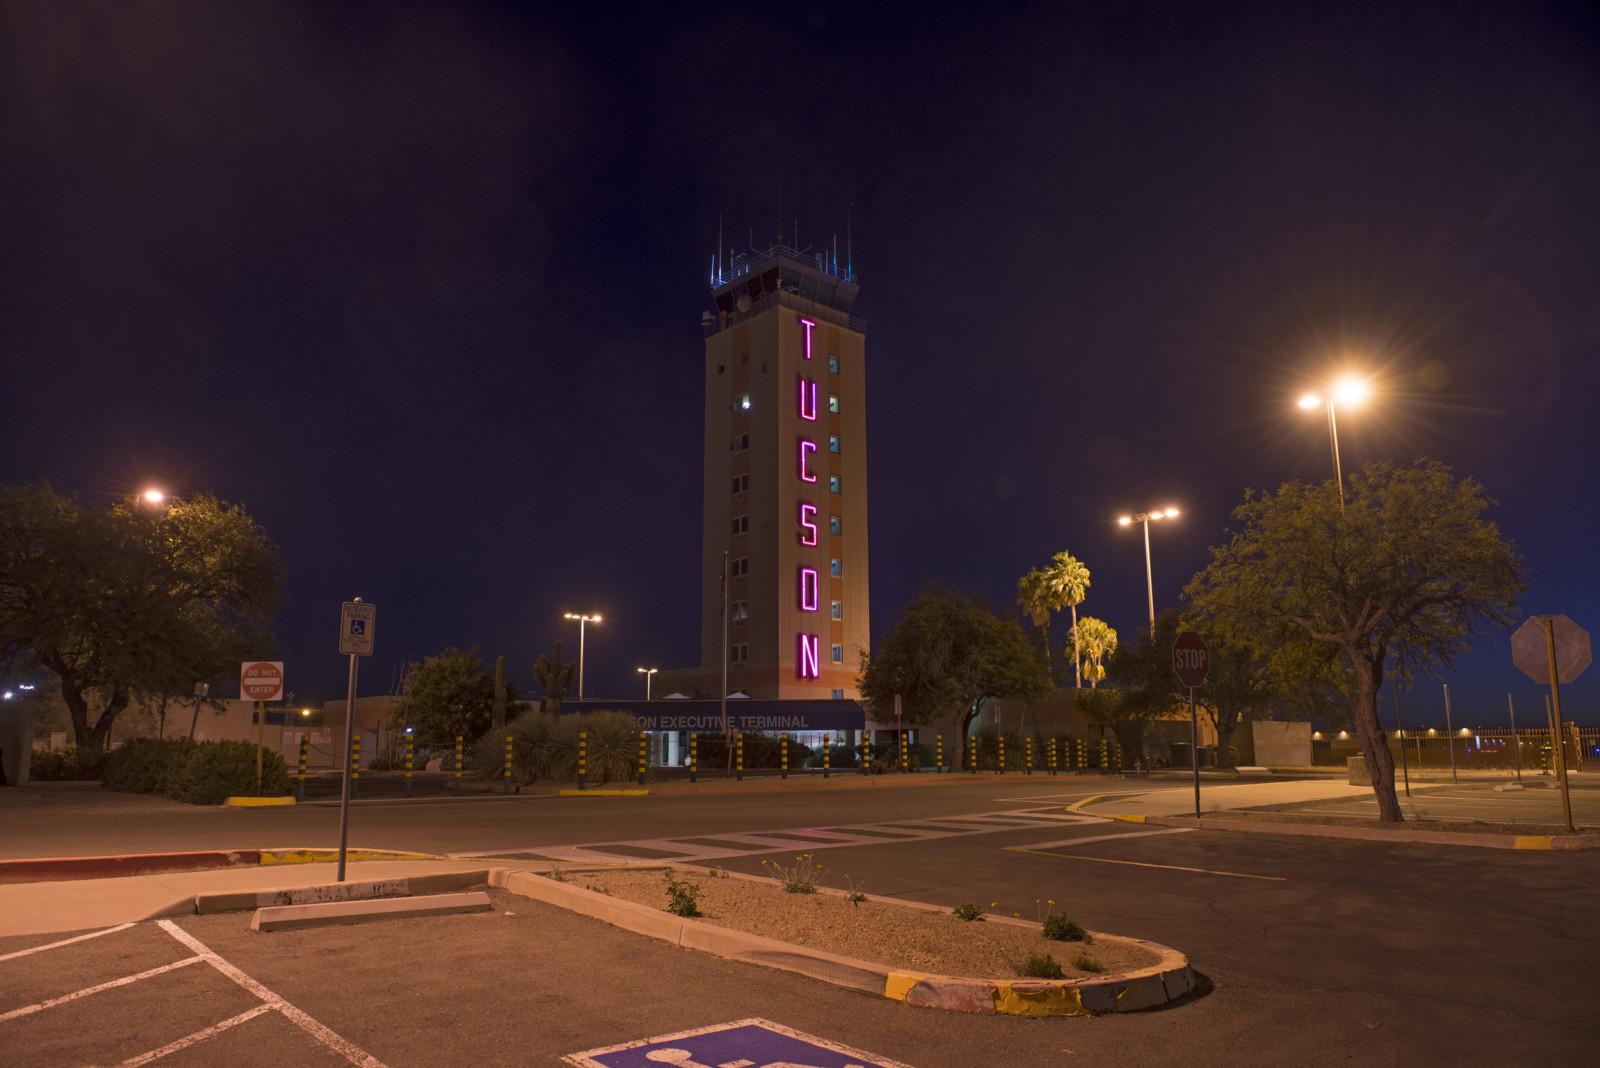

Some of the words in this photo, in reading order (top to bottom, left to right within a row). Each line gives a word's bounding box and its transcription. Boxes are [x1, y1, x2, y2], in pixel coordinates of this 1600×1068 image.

[800, 318, 819, 679] TUCSON
[1175, 648, 1206, 669] STOP
[248, 669, 258, 677] DO
[262, 669, 277, 677] NOT
[250, 686, 274, 694] ENTER
[739, 716, 809, 728] TERMINAL
